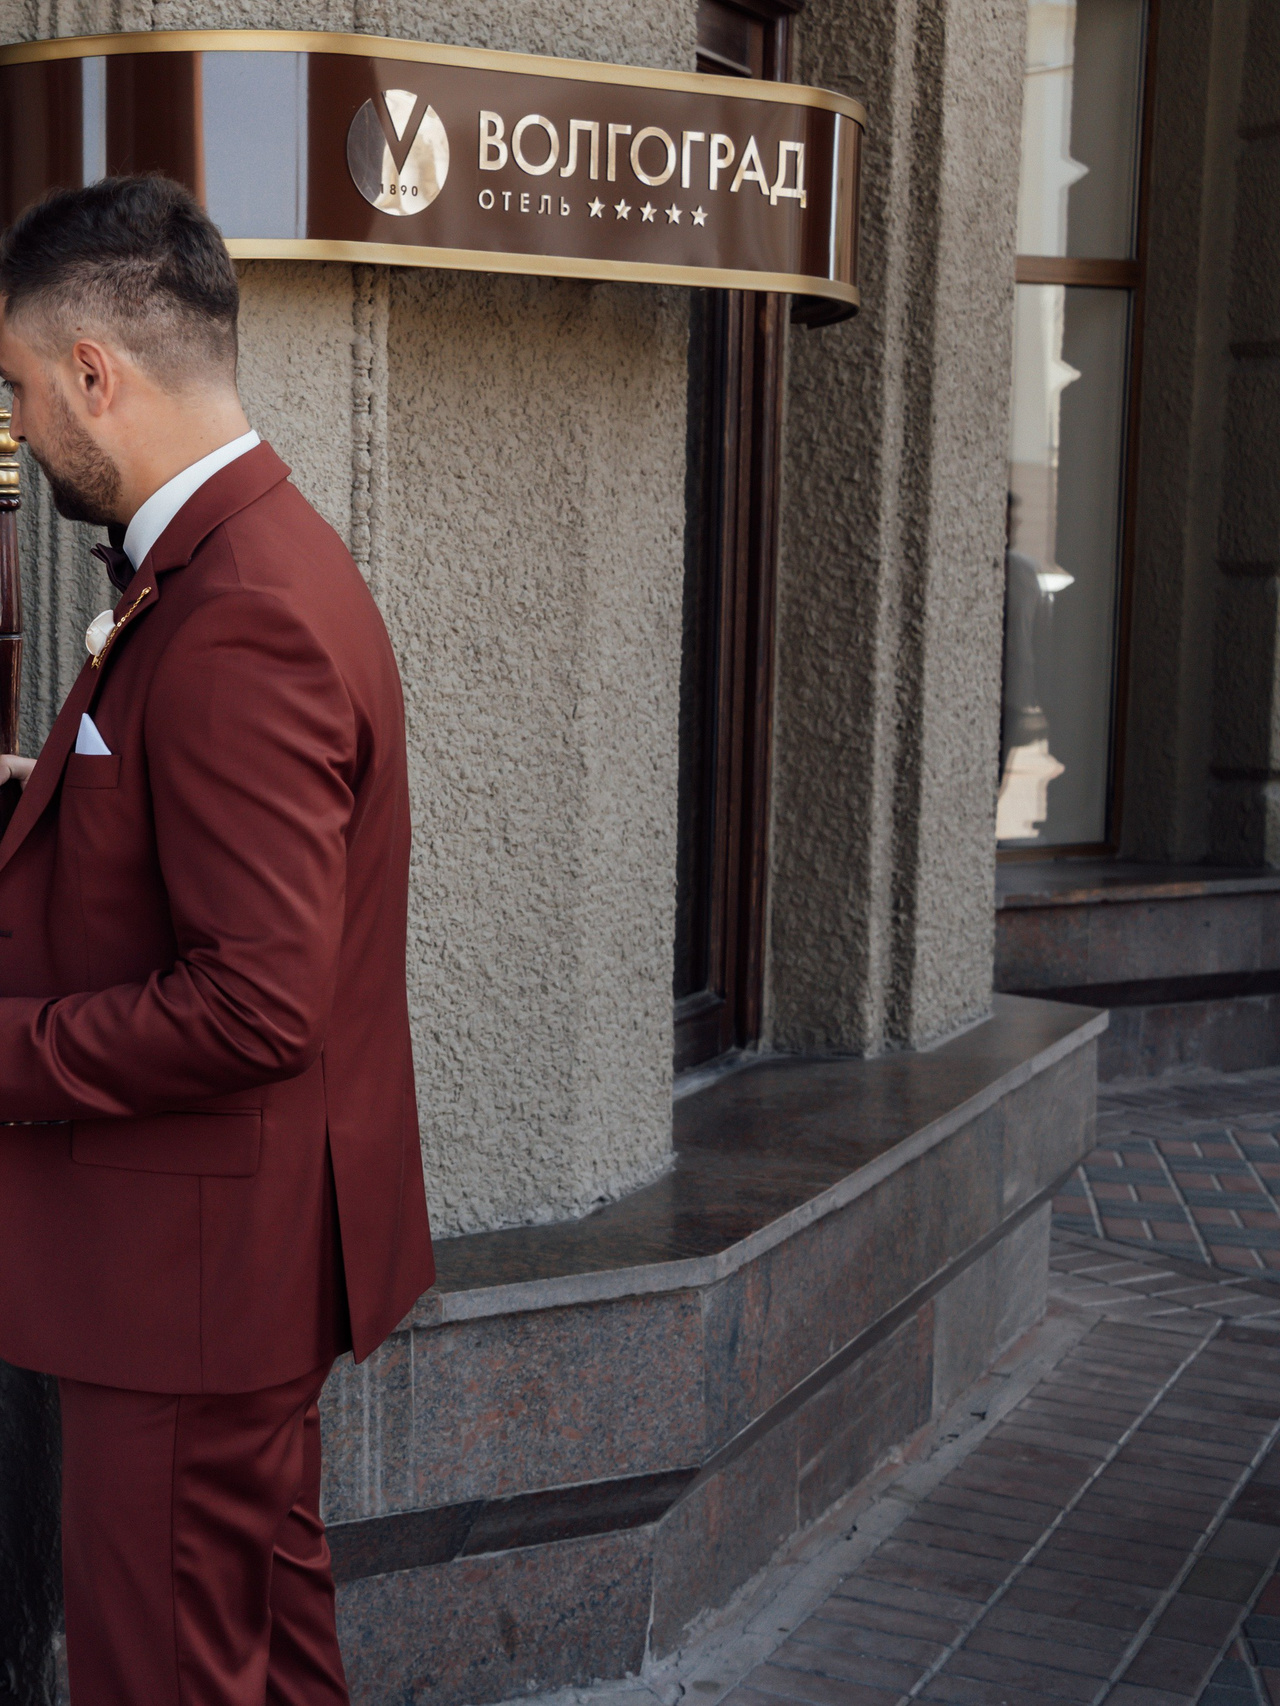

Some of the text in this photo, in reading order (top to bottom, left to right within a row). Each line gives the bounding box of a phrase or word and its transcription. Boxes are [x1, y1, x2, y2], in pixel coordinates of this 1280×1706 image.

[478, 109, 807, 209] ВОЛГОГРАД
[380, 183, 419, 197] 1890
[478, 188, 571, 216] ОТЕЛЬ
